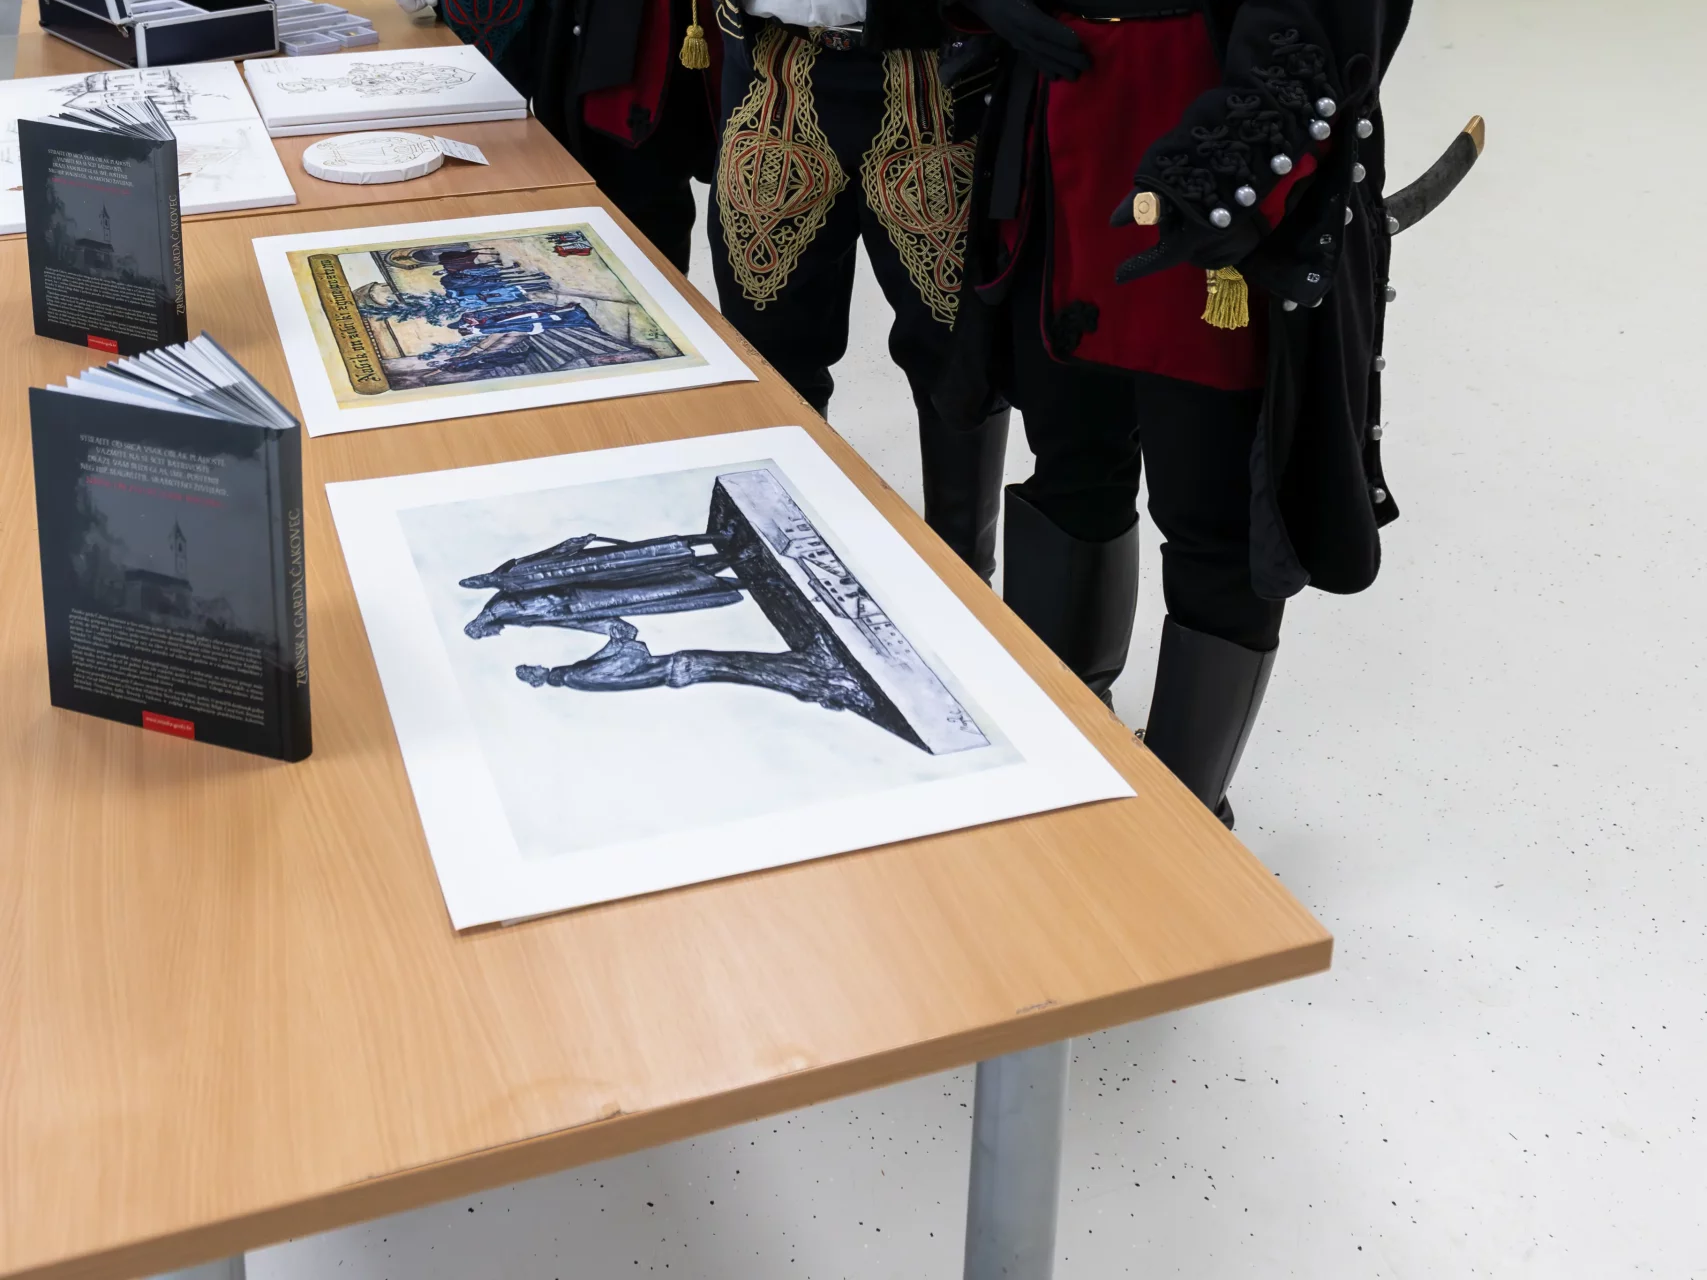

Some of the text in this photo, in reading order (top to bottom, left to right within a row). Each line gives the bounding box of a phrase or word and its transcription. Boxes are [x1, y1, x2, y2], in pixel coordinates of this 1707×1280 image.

[168, 194, 185, 315] ZRINSKA GARDA ČAKOVEC
[347, 353, 381, 383] Navik
[350, 338, 365, 352] on
[288, 507, 309, 688] ZRINSKA GARDA ČAKOVEC
